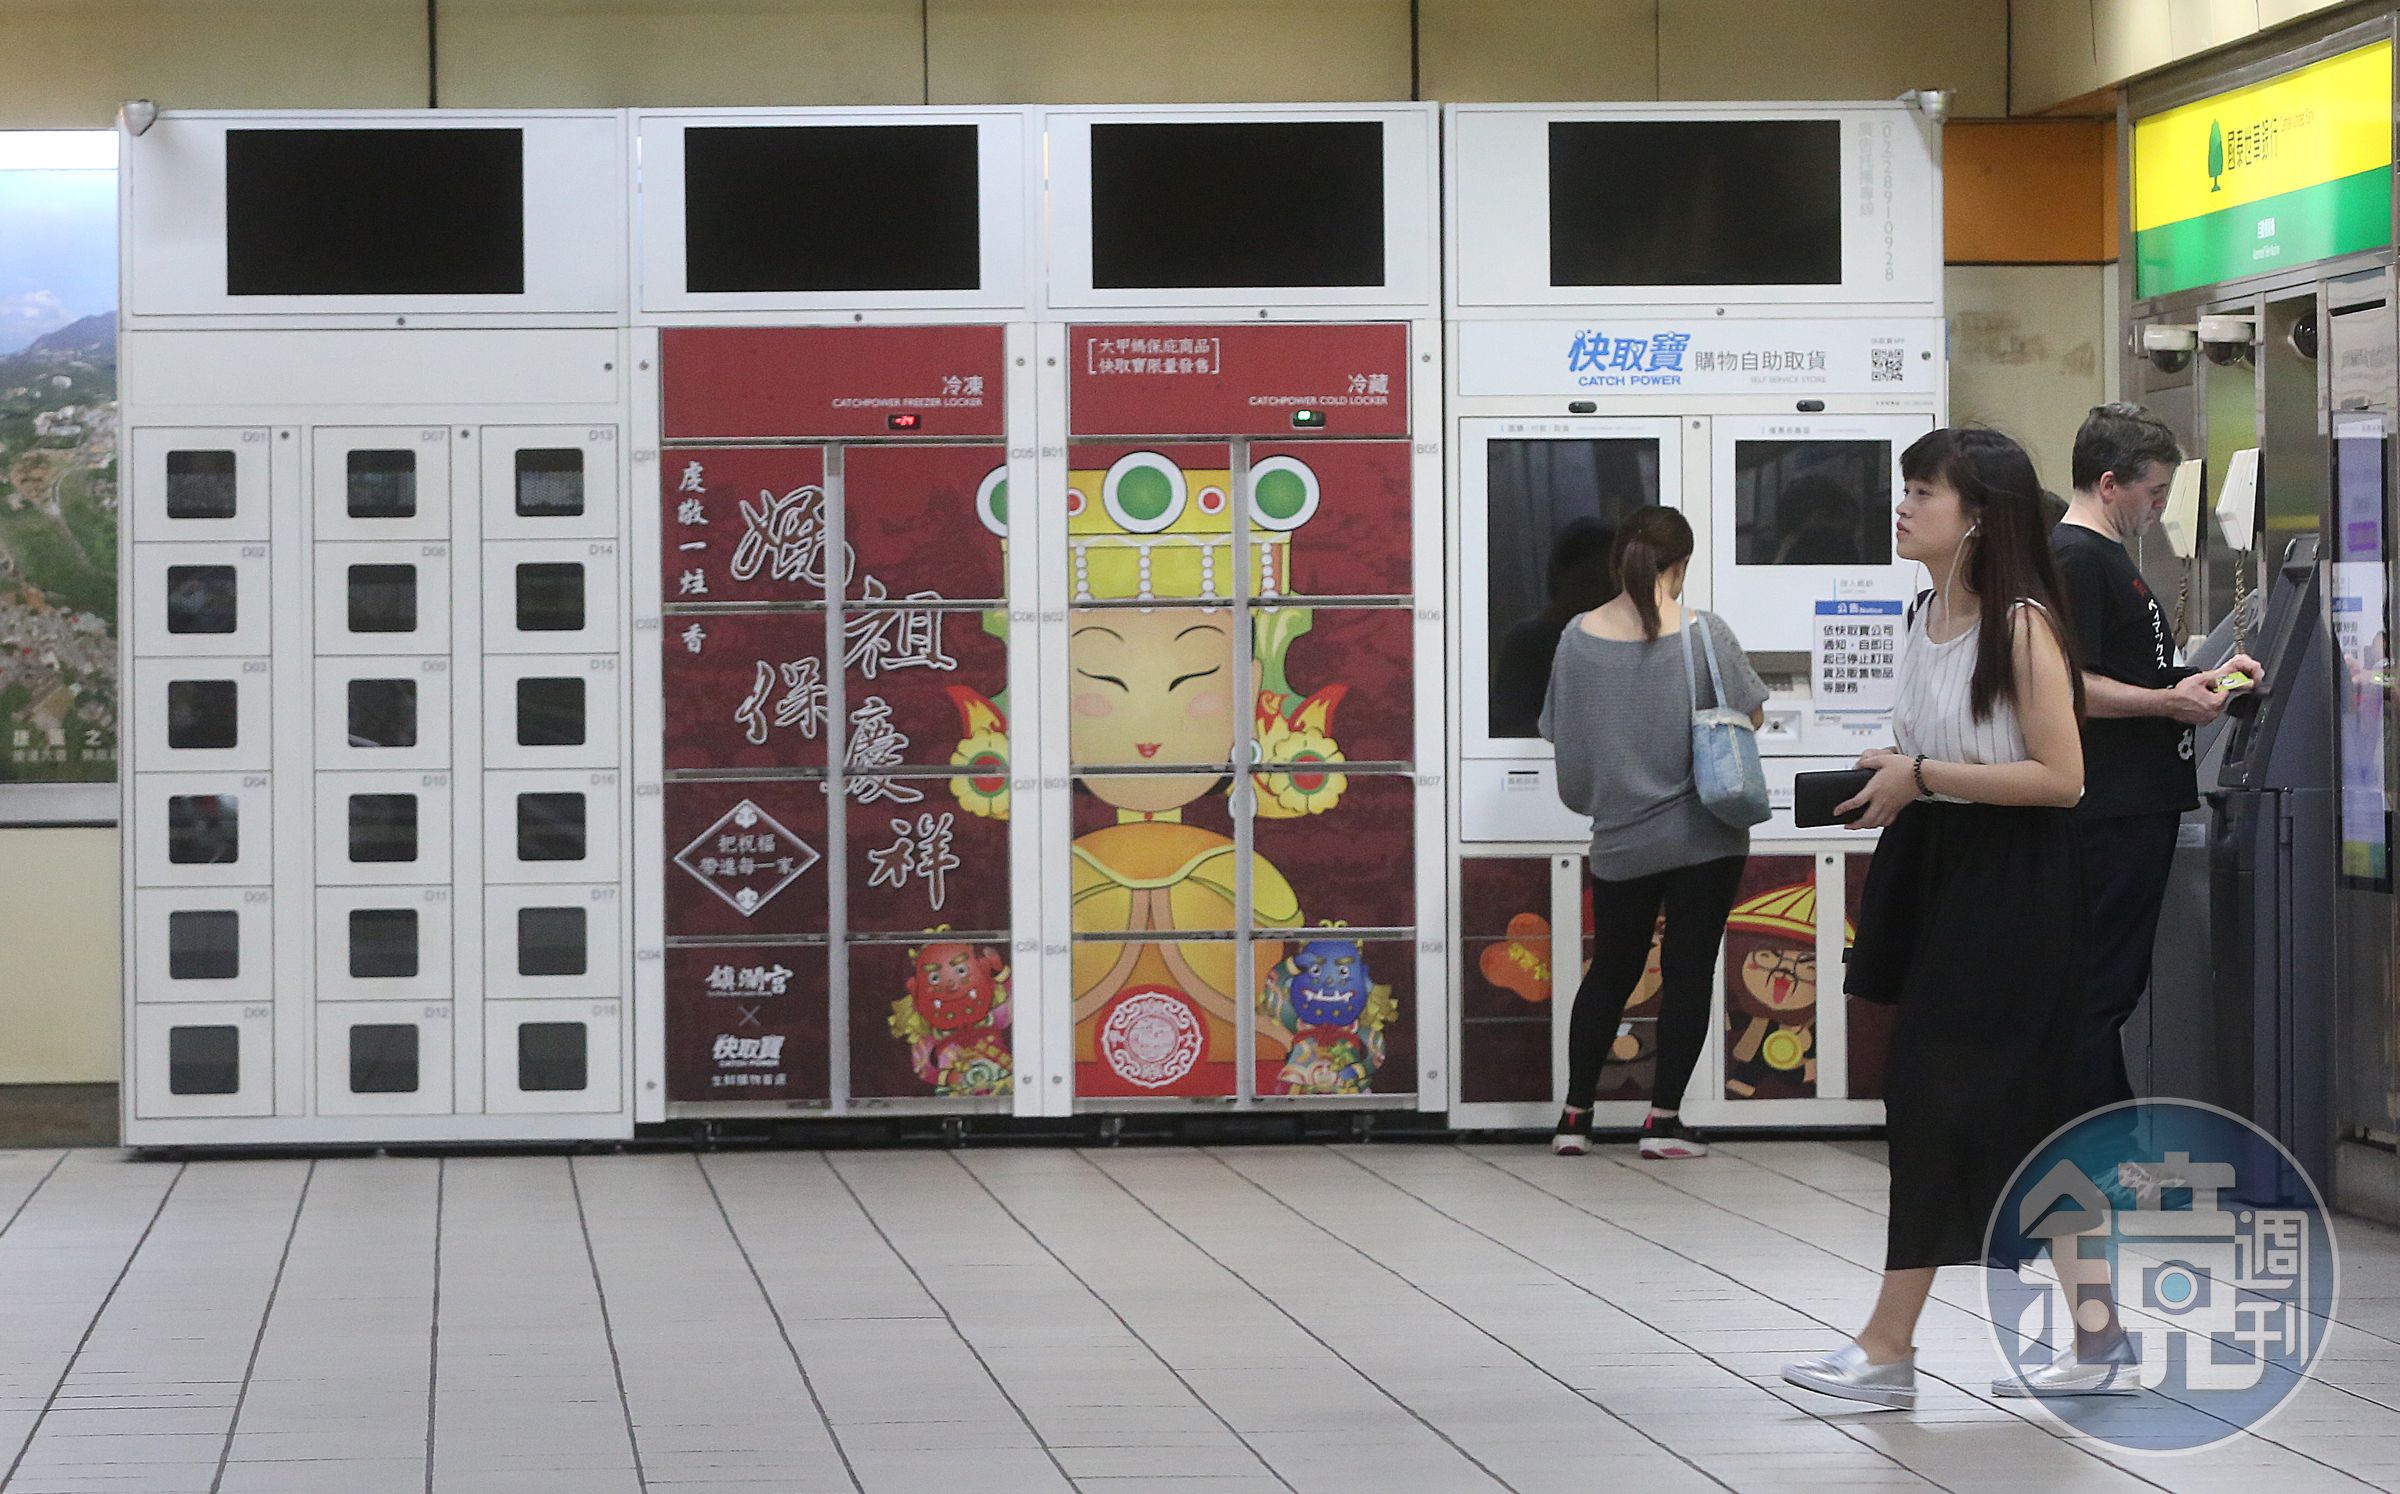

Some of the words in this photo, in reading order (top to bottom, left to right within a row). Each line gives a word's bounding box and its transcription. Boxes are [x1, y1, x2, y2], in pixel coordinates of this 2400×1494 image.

[1567, 329, 1692, 373] 快取寶
[1694, 350, 1827, 372] 購物自助取貨
[942, 375, 984, 396] 冷凍
[1347, 373, 1390, 395] 冷藏
[1578, 375, 1626, 387] CATCH
[1629, 374, 1682, 386] POWER
